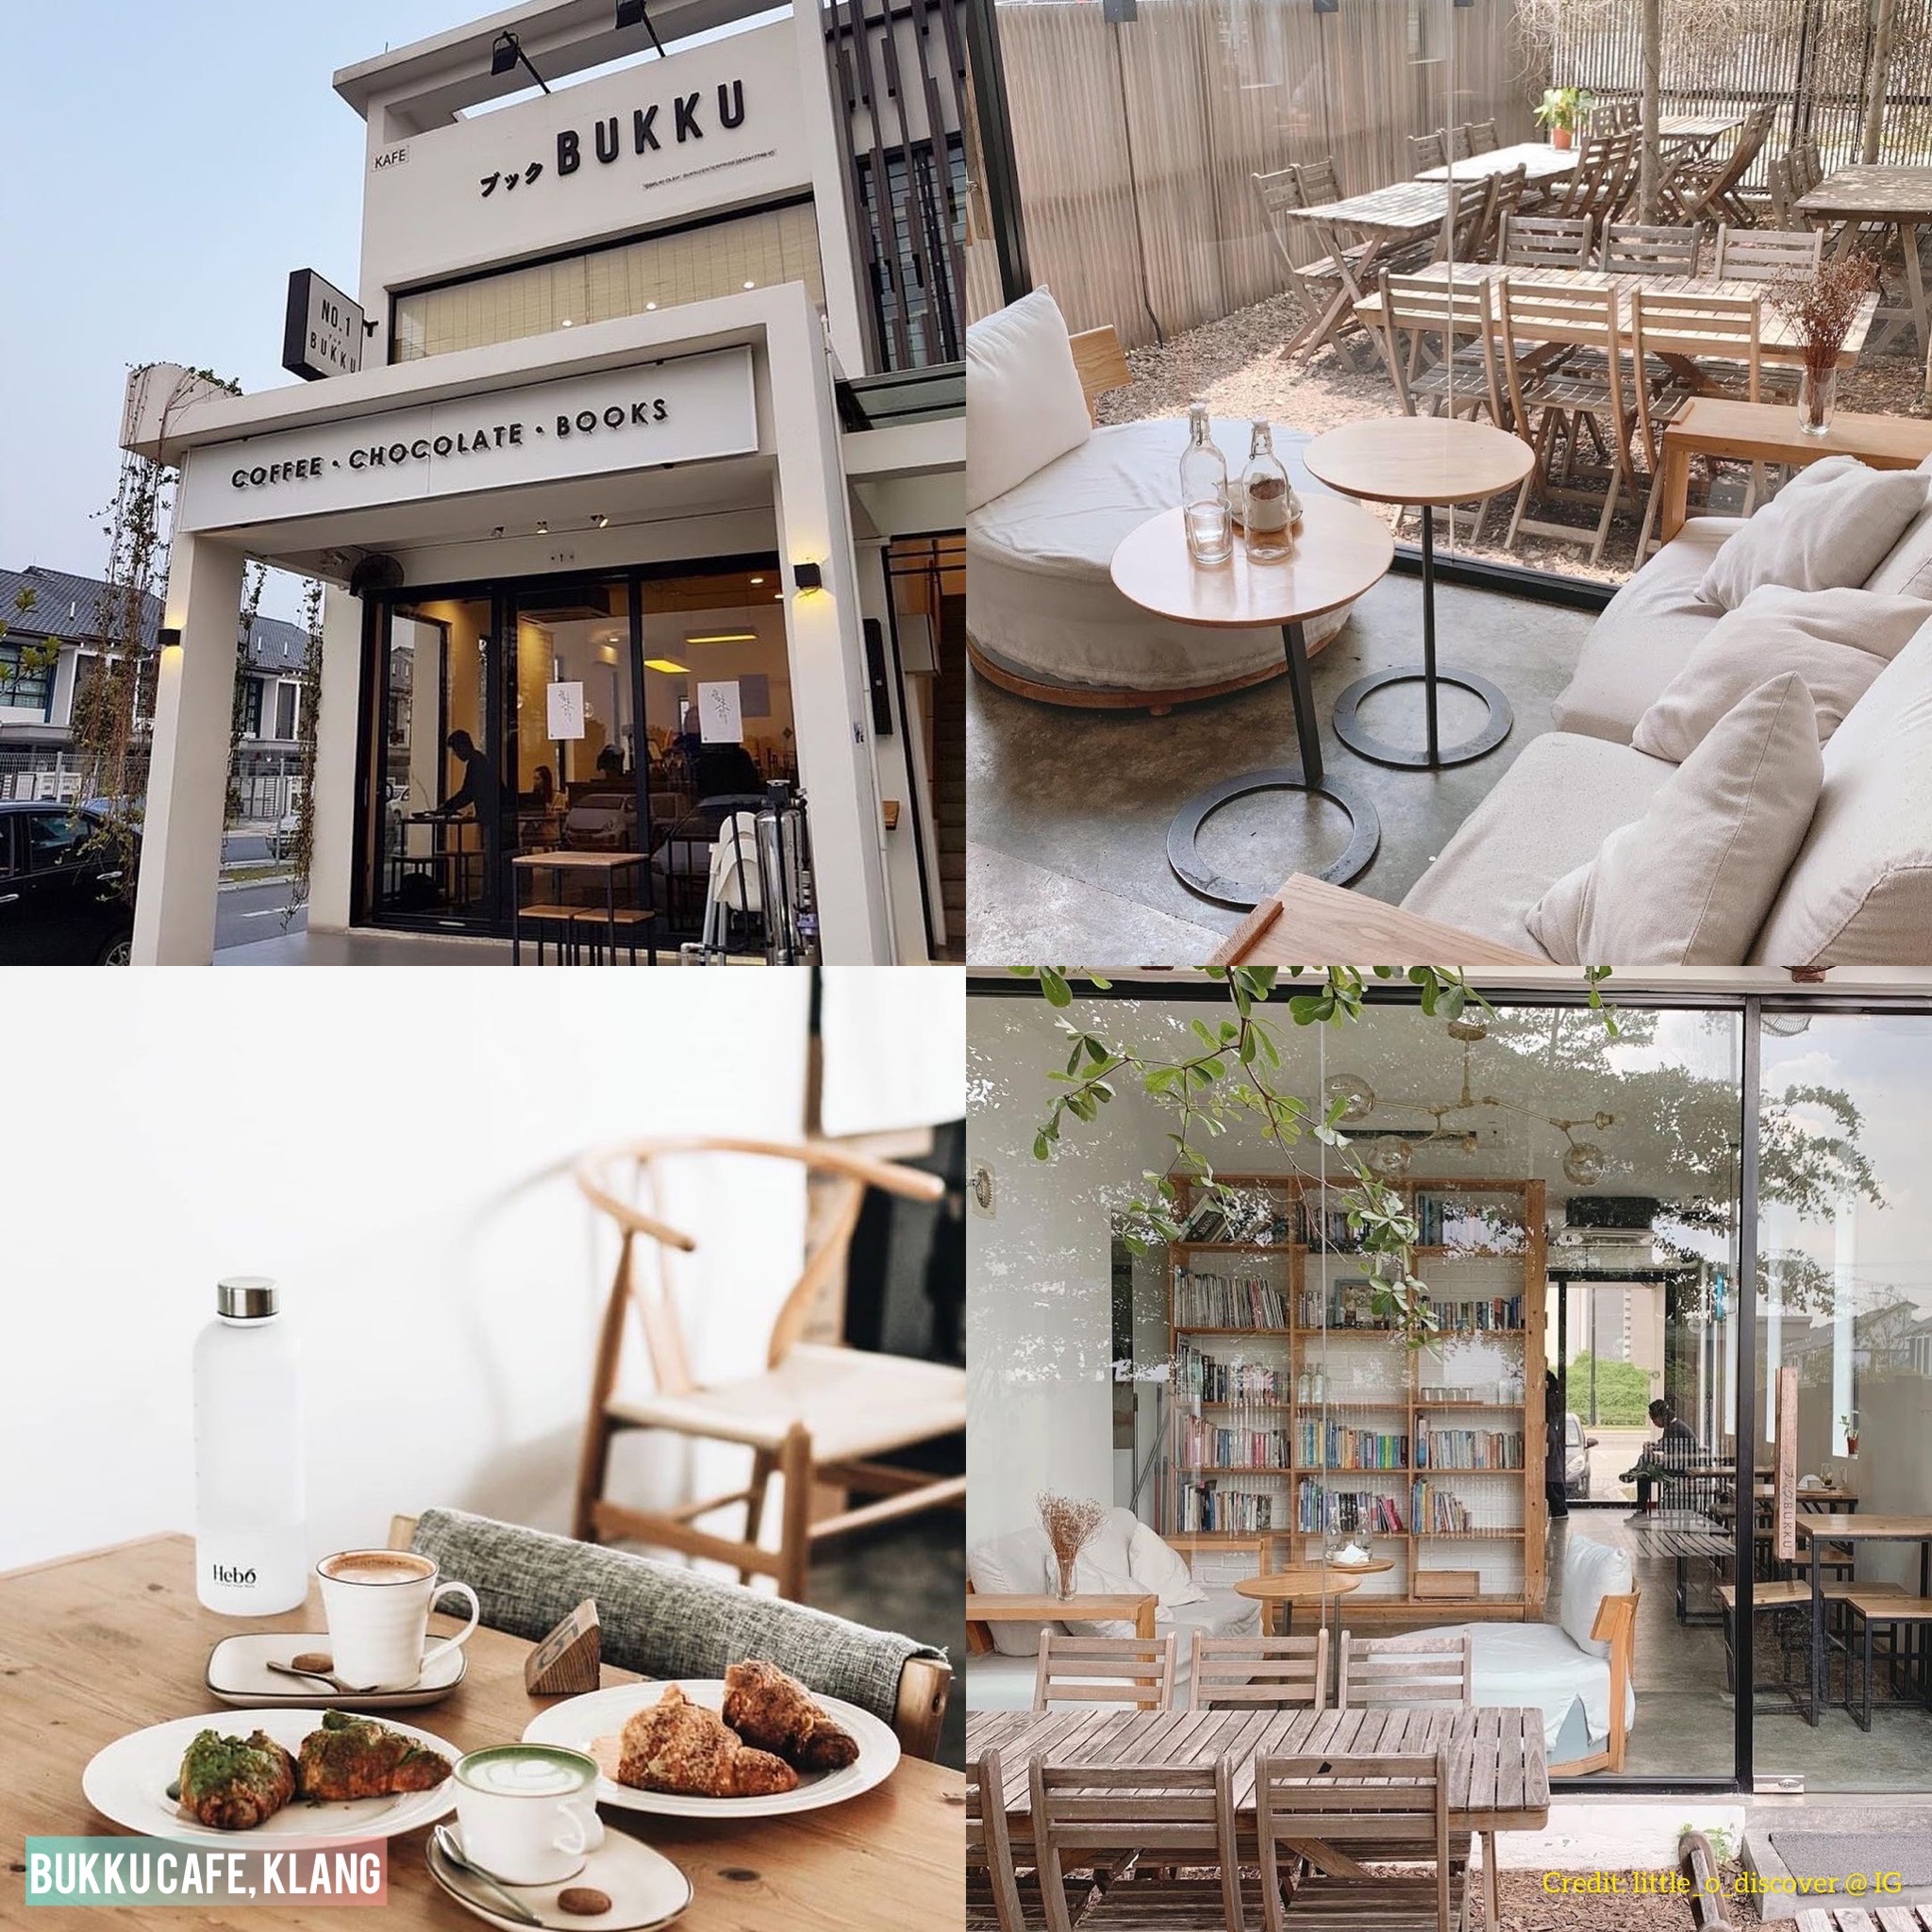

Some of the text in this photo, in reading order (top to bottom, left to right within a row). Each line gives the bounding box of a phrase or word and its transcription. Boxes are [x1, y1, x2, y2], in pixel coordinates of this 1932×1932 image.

[375, 148, 406, 169] KAFE
[480, 161, 543, 197] ブック
[557, 79, 745, 176] BUKKU
[322, 299, 351, 337] NO.1
[310, 332, 357, 373] BUKKU
[231, 398, 669, 489] COFFEE CHOCOLATE BOOKS
[1782, 1502, 1793, 1548] BUKKU
